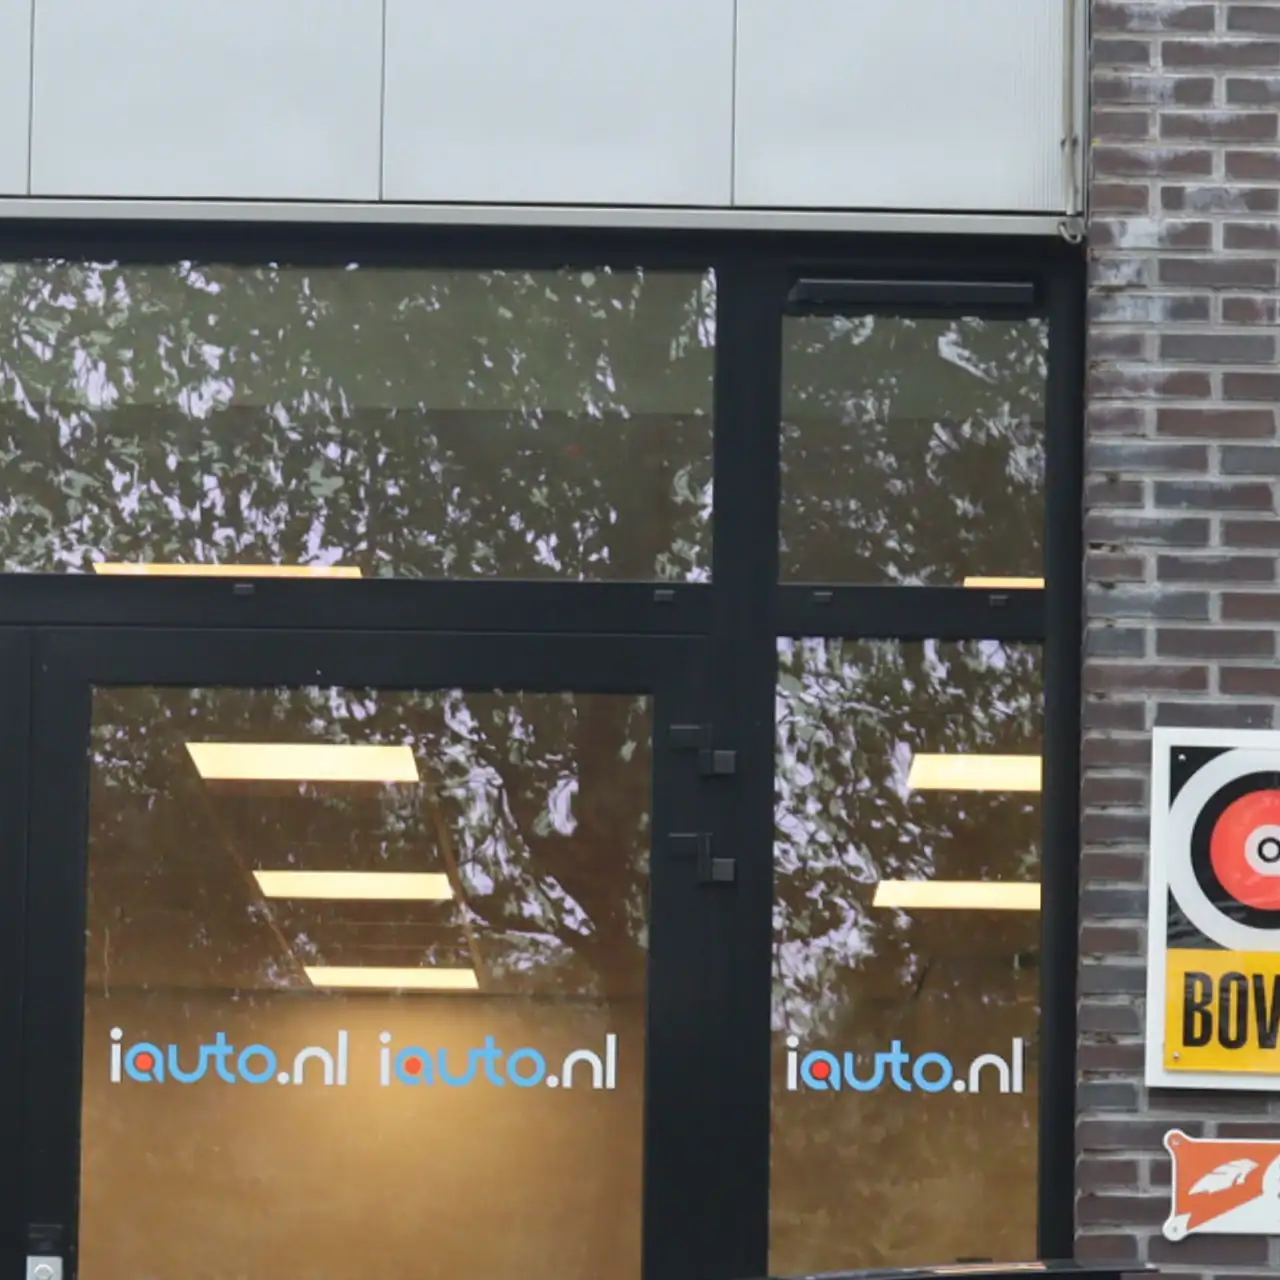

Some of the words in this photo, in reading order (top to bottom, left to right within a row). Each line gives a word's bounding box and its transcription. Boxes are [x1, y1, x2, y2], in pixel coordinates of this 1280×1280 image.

[110, 1027, 348, 1085] iauto.nl
[379, 1031, 616, 1089] iauto.nl
[786, 1035, 1023, 1093] iauto.nl
